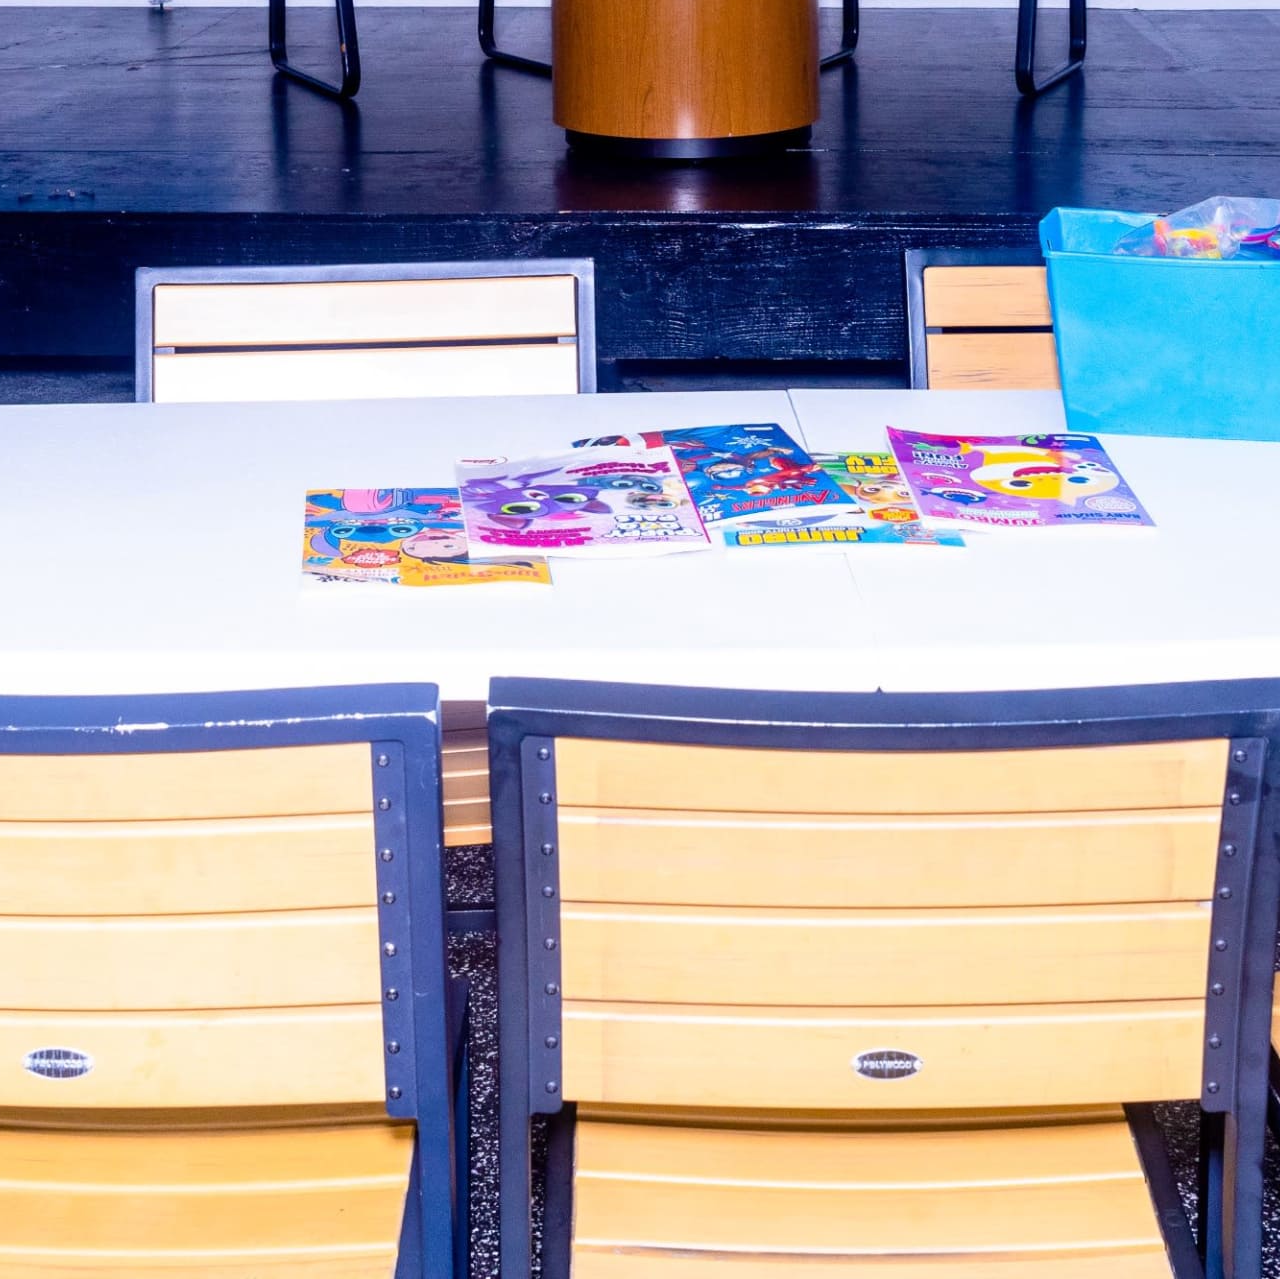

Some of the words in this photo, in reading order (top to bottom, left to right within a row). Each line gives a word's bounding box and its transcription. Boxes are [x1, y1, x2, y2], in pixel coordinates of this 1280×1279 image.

[730, 490, 829, 512] AVENGERS
[614, 514, 679, 523] PALS
[600, 526, 702, 538] PUPPY
[737, 528, 862, 547] JUMBO
